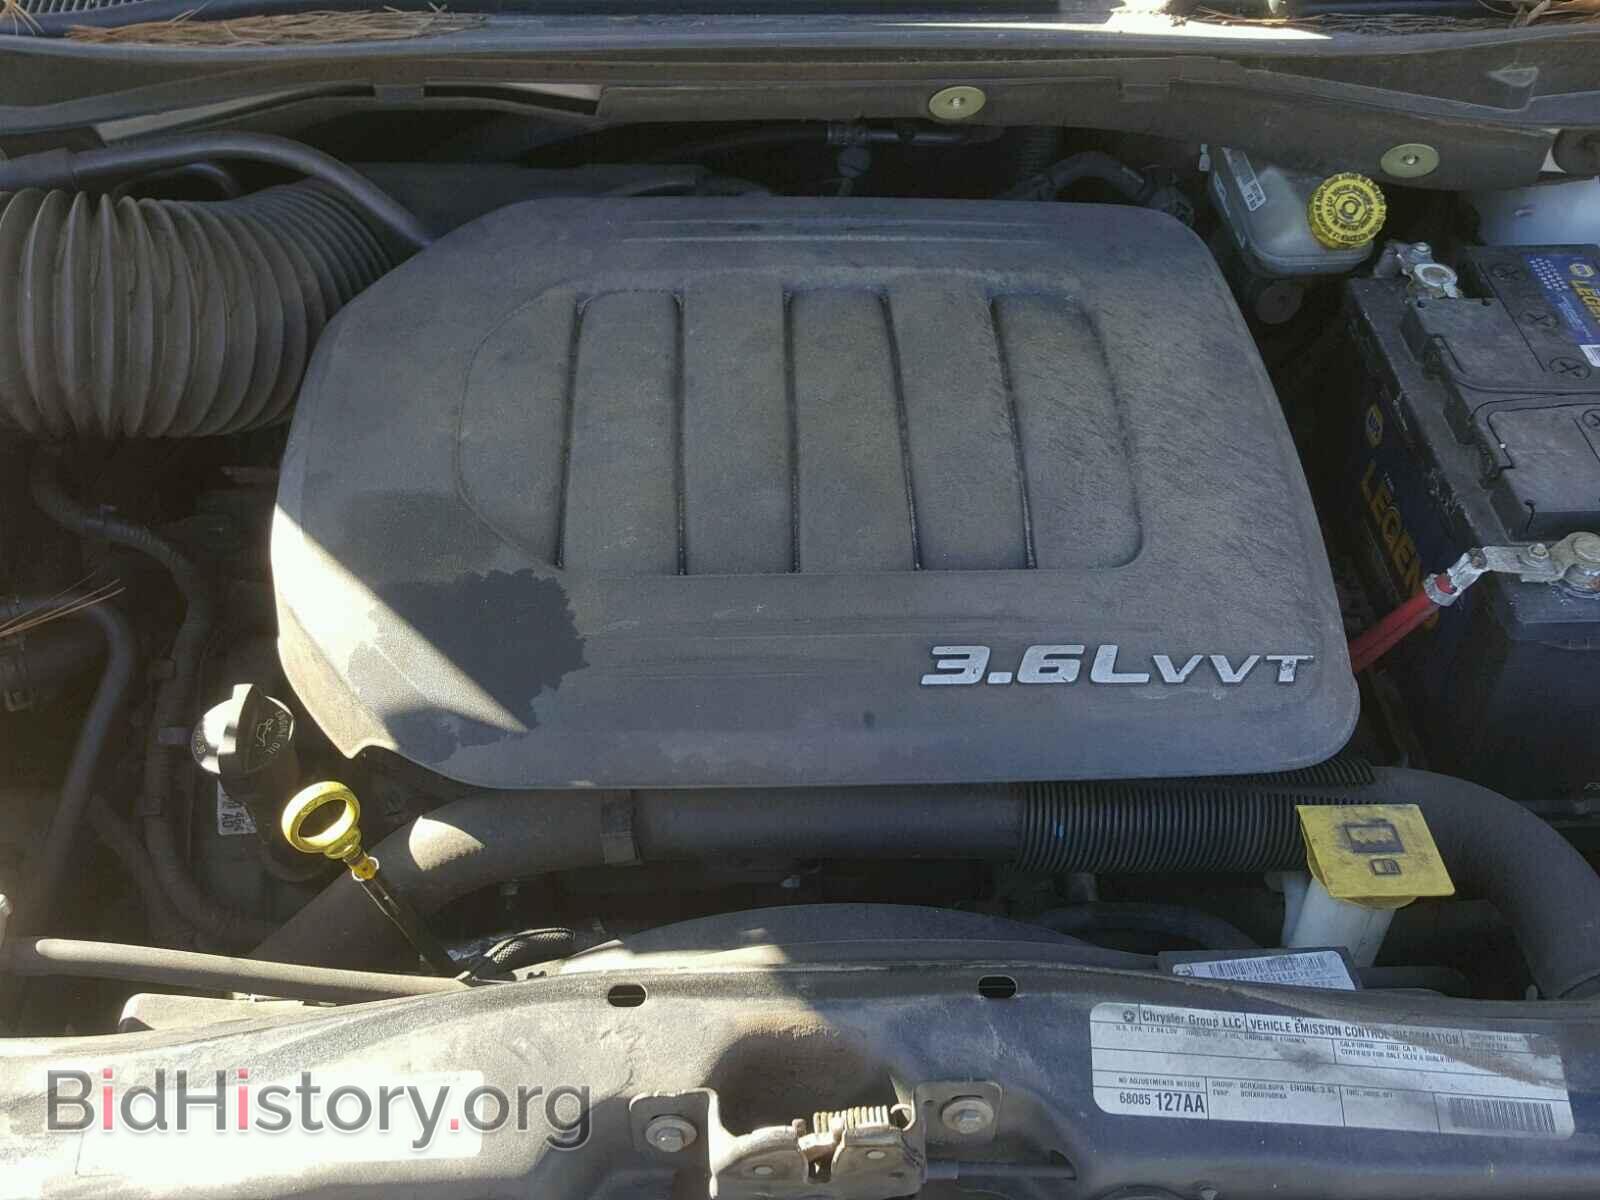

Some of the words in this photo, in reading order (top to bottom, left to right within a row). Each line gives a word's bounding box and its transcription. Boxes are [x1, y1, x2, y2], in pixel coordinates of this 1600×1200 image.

[920, 644, 1151, 685] 3.6L
[1151, 654, 1314, 684] VVT
[1142, 1010, 1185, 1025] Chrysler
[1188, 1014, 1219, 1028] Group
[1222, 1016, 1242, 1029] LLC
[1250, 1019, 1291, 1033] VEHICLE
[1295, 1022, 1342, 1037] EMISSION
[1345, 1026, 1390, 1041] CONTROL
[1119, 1091, 1151, 1106] 68085
[1155, 1092, 1206, 1114] 127AA
